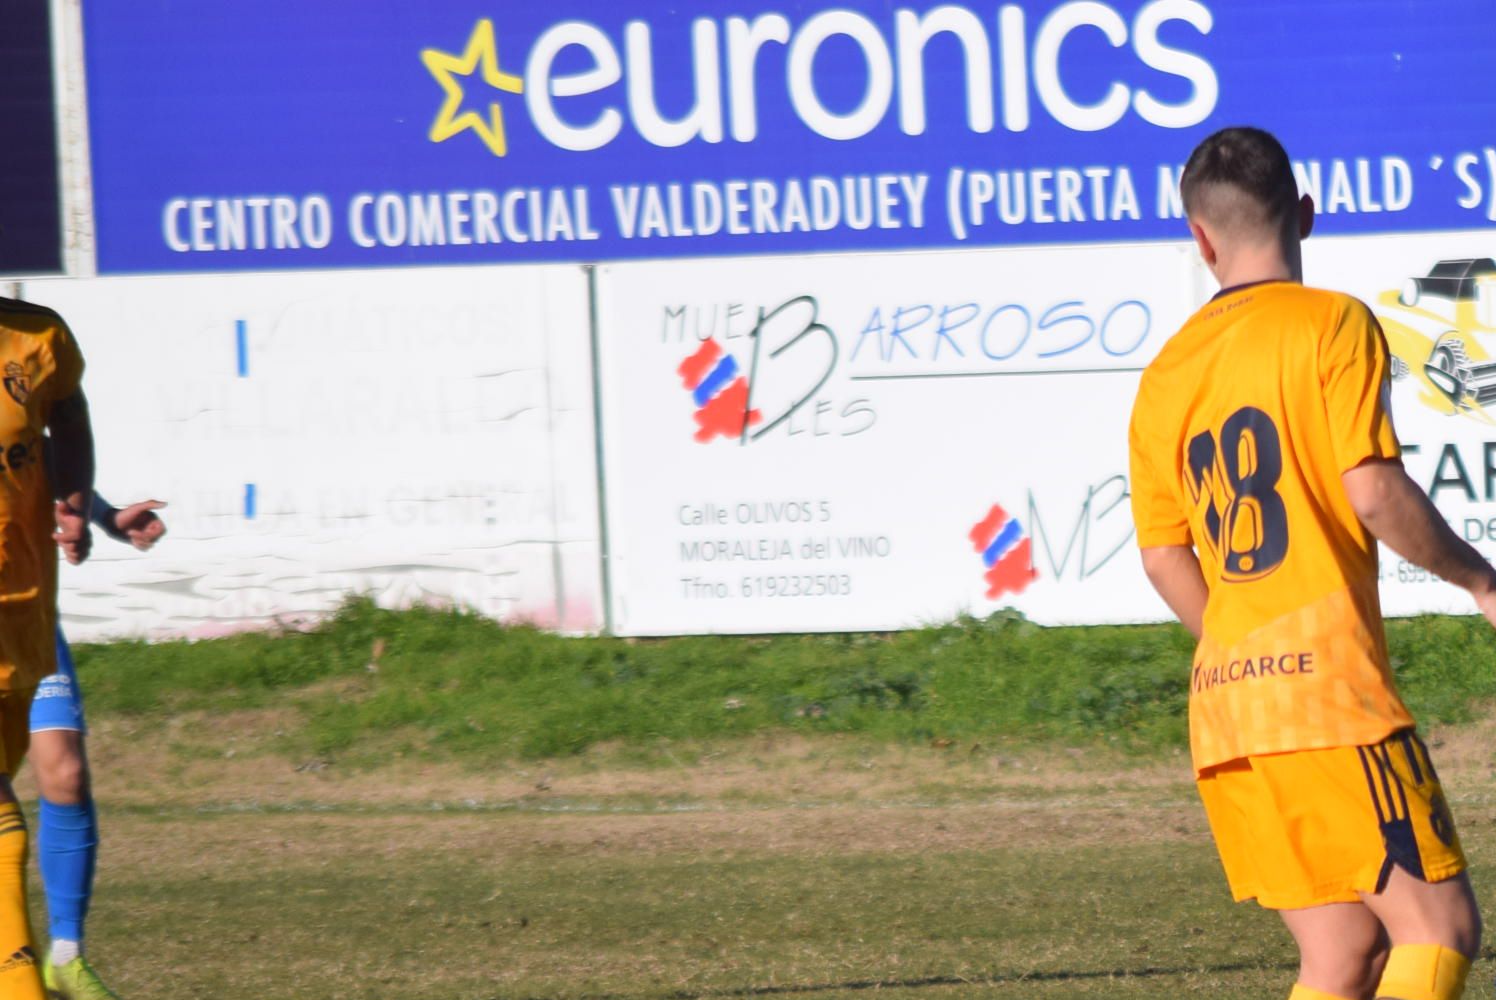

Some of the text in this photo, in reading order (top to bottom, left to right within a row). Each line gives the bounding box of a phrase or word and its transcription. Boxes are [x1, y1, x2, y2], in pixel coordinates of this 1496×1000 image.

[525, 0, 1220, 152] euronics
[164, 194, 333, 253] CENTRO
[350, 186, 600, 249] COMERCIAL
[610, 175, 929, 240] VALDERADUEY
[947, 166, 1141, 241] (PUERTA
[678, 500, 831, 527] Calle OLIVOS 5
[679, 534, 892, 563] MORALEJA del VINO
[740, 573, 853, 599] 619232503
[1202, 651, 1314, 692] VALCARCE
